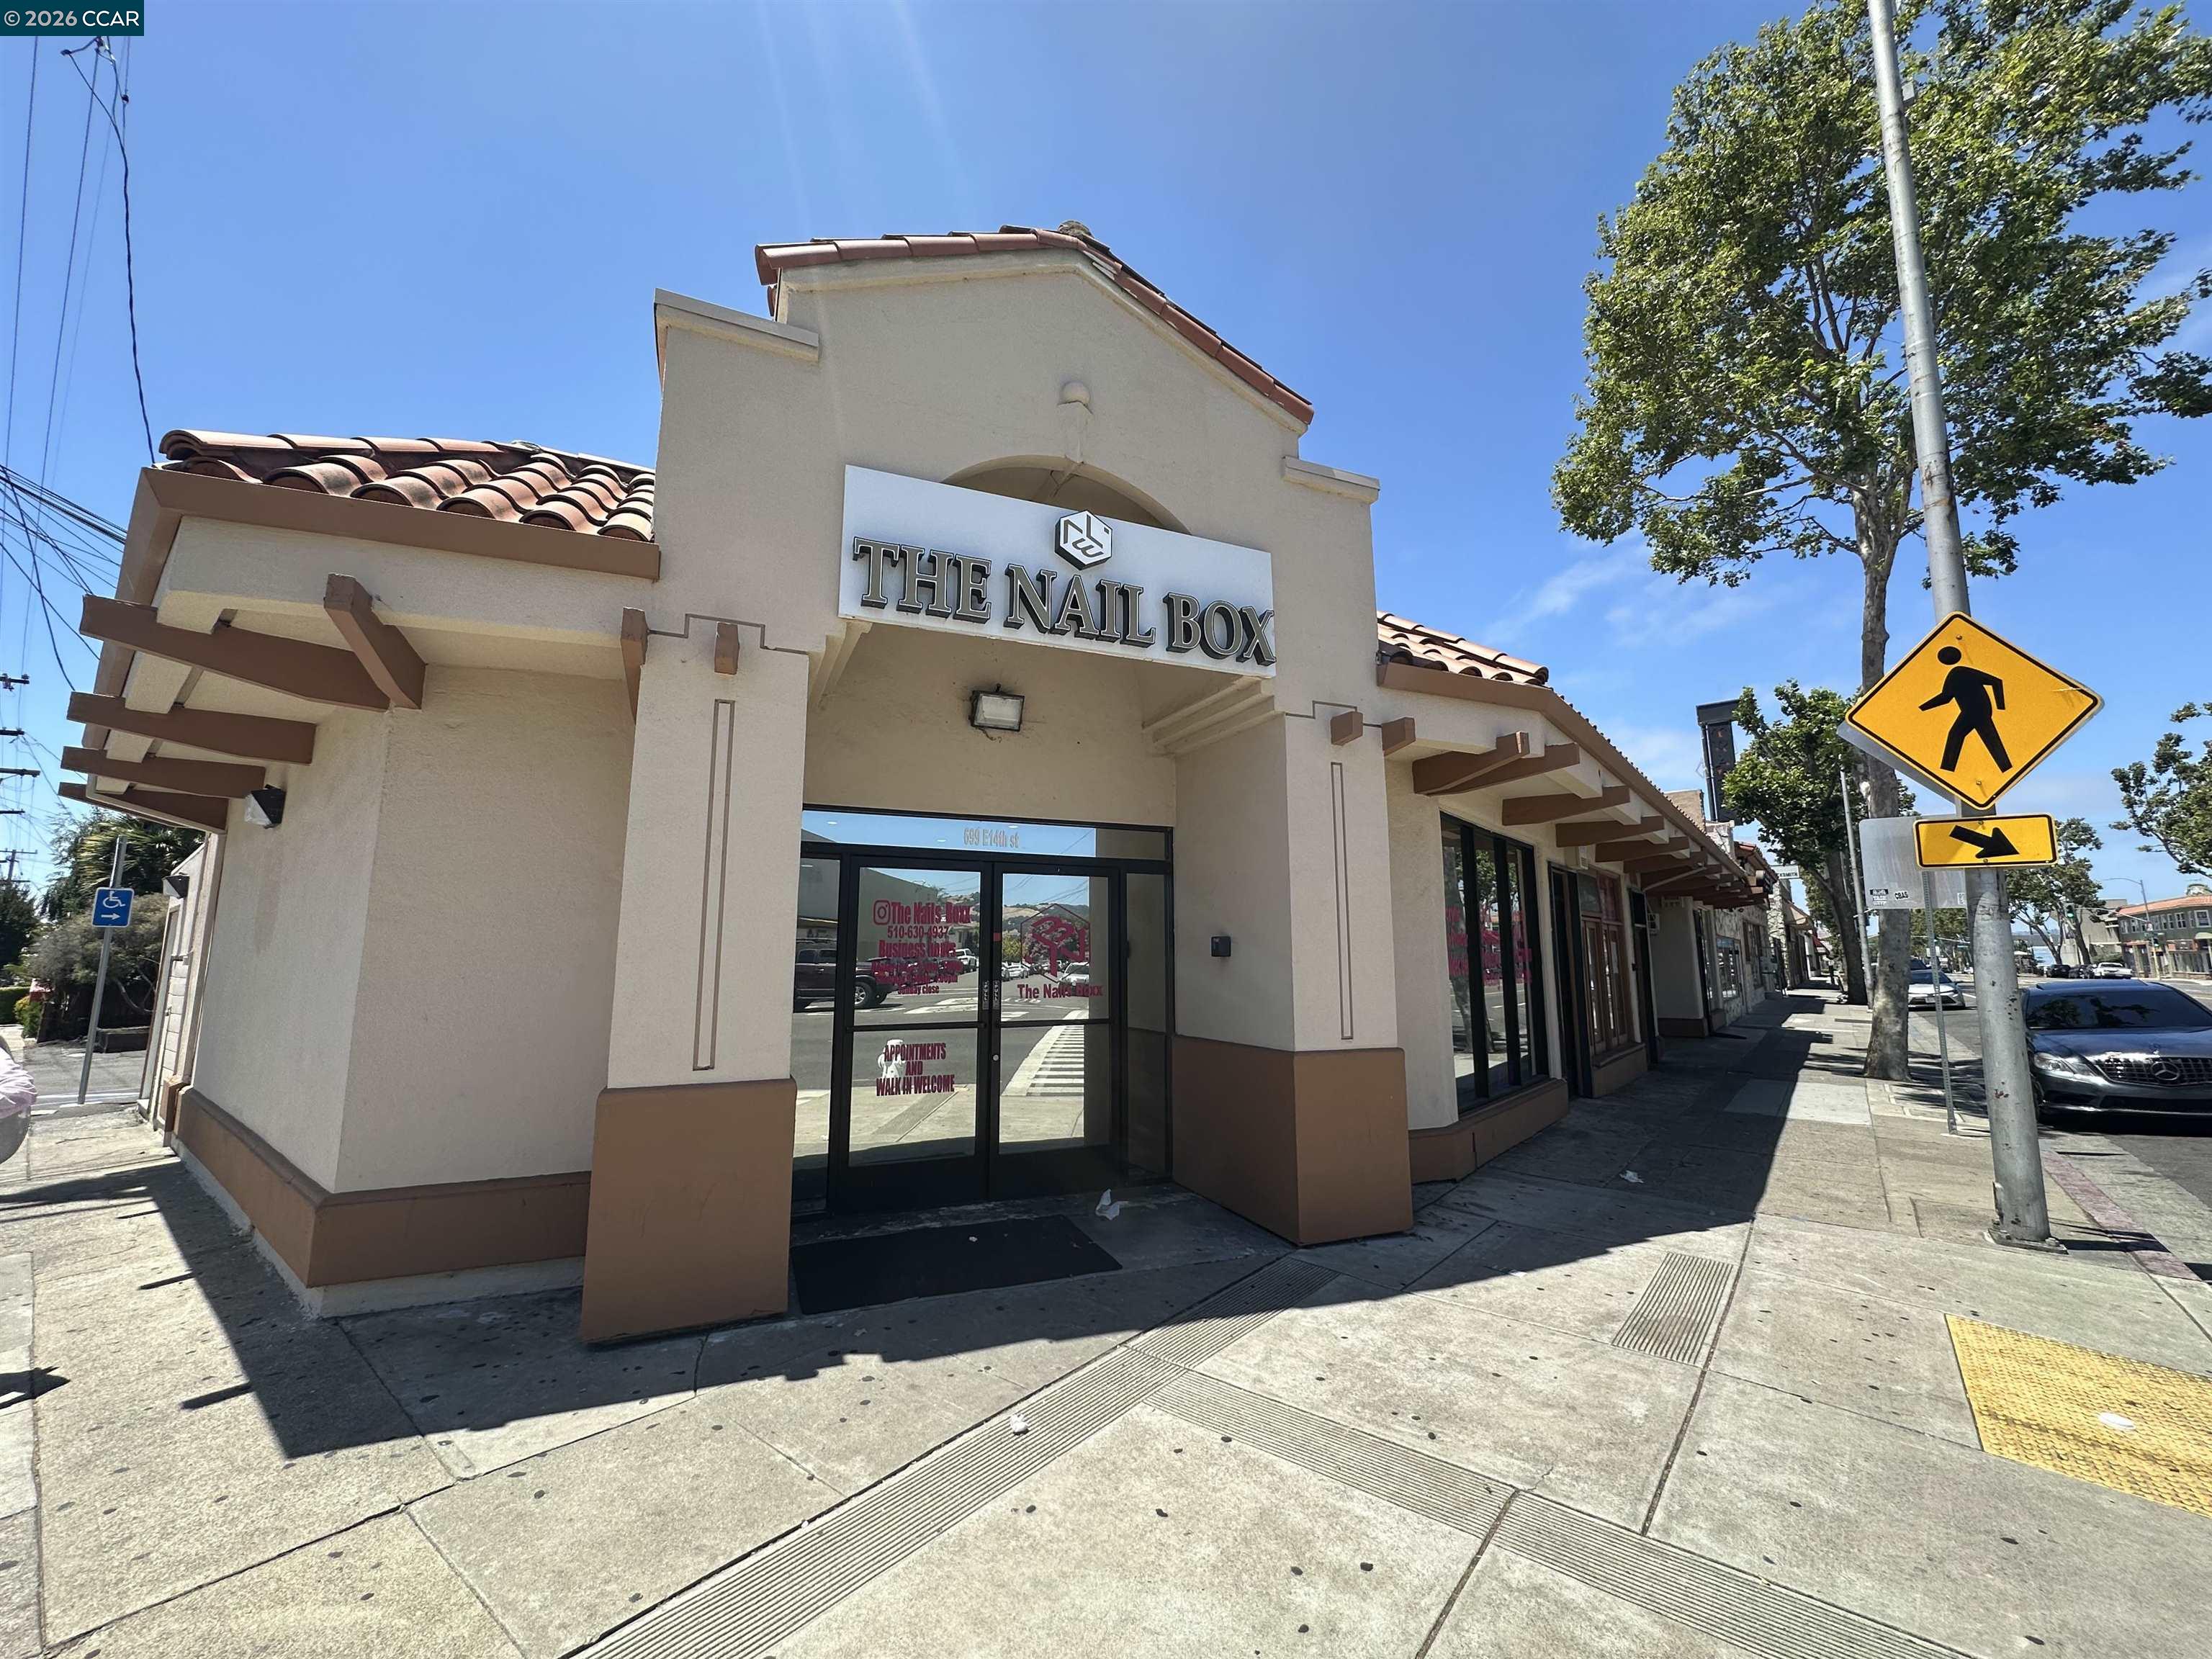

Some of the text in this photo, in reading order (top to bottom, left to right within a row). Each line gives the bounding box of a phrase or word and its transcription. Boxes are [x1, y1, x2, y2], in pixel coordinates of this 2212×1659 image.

[853, 536, 1277, 667] THE NAIL BOX
[891, 902, 911, 925] The
[914, 902, 942, 925] Nails
[878, 940, 926, 958] Business
[922, 984, 940, 994] close
[1017, 982, 1104, 999] The Nails Boxx
[884, 1043, 947, 1062] APPOINTMENTS
[905, 1061, 923, 1076] AND
[914, 1074, 956, 1094] WELCOME
